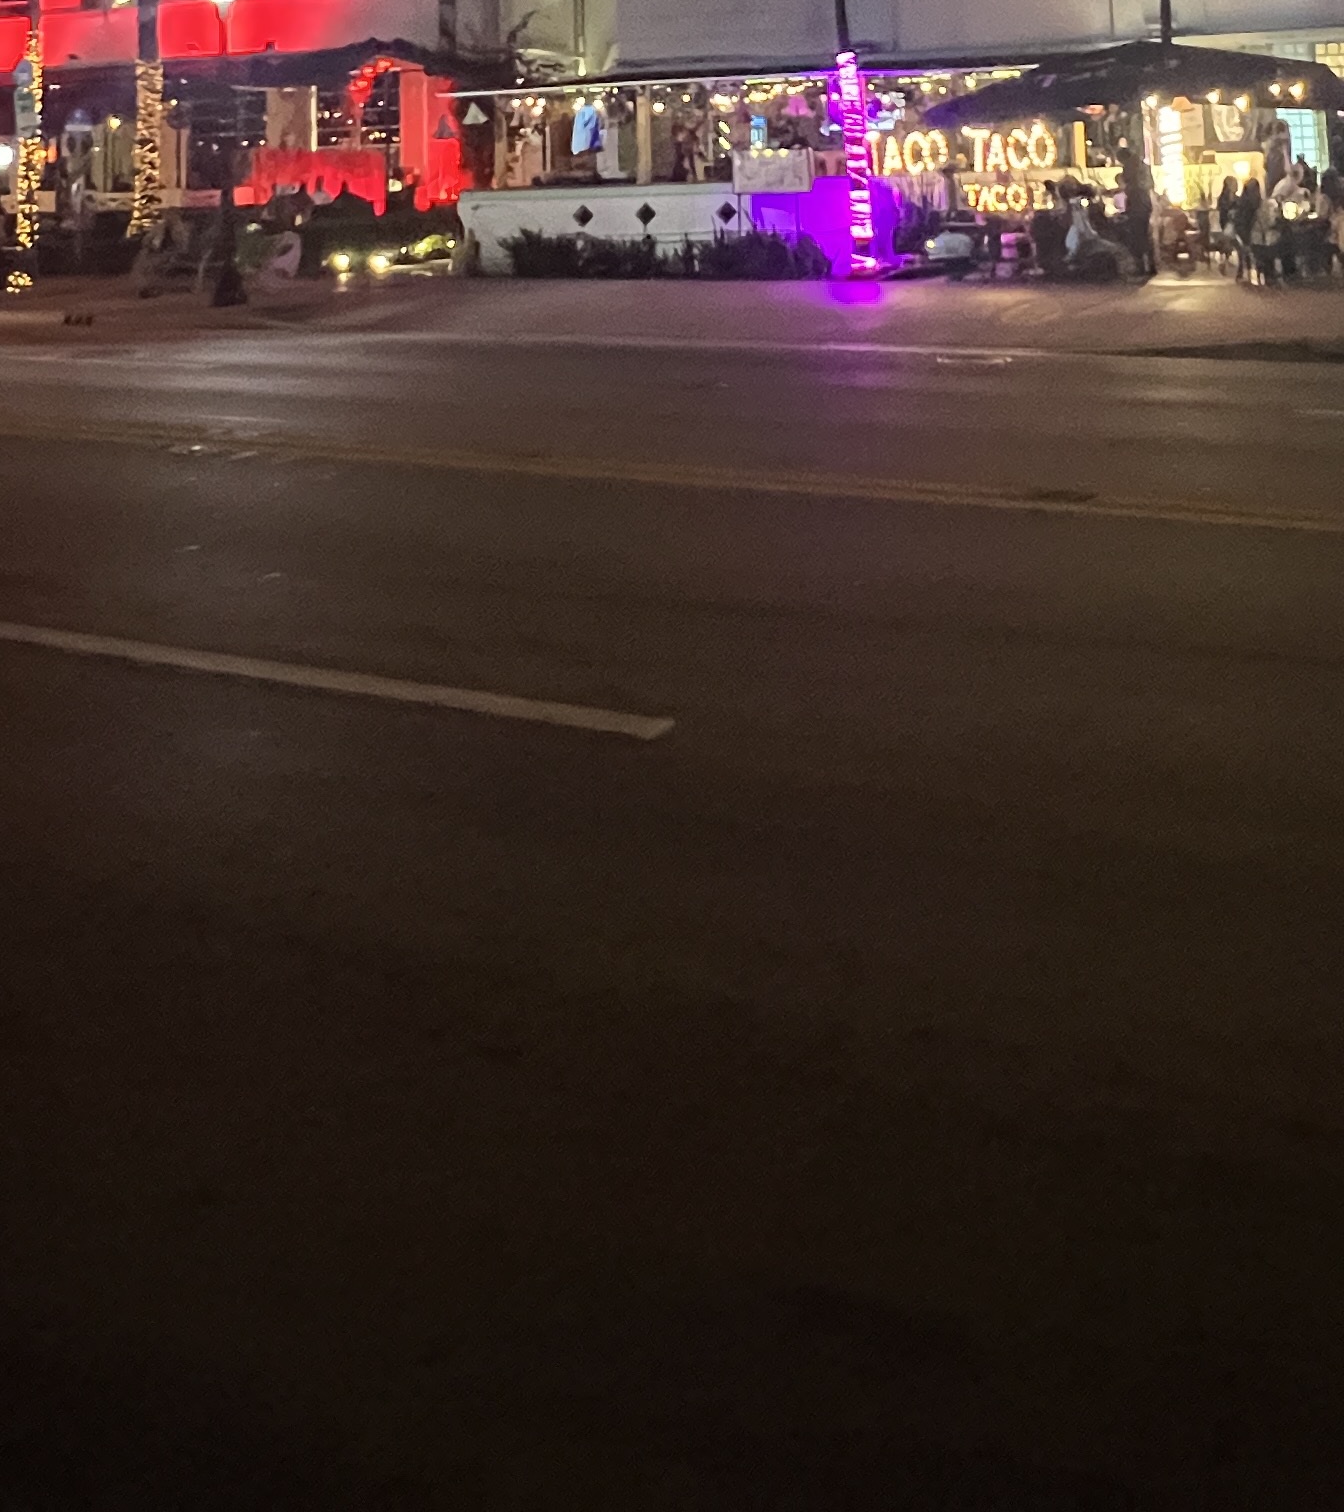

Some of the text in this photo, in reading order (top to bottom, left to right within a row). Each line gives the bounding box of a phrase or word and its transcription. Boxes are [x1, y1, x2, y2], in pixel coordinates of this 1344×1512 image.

[864, 123, 1057, 176] TACO TACO
[962, 183, 1028, 212] TACO
